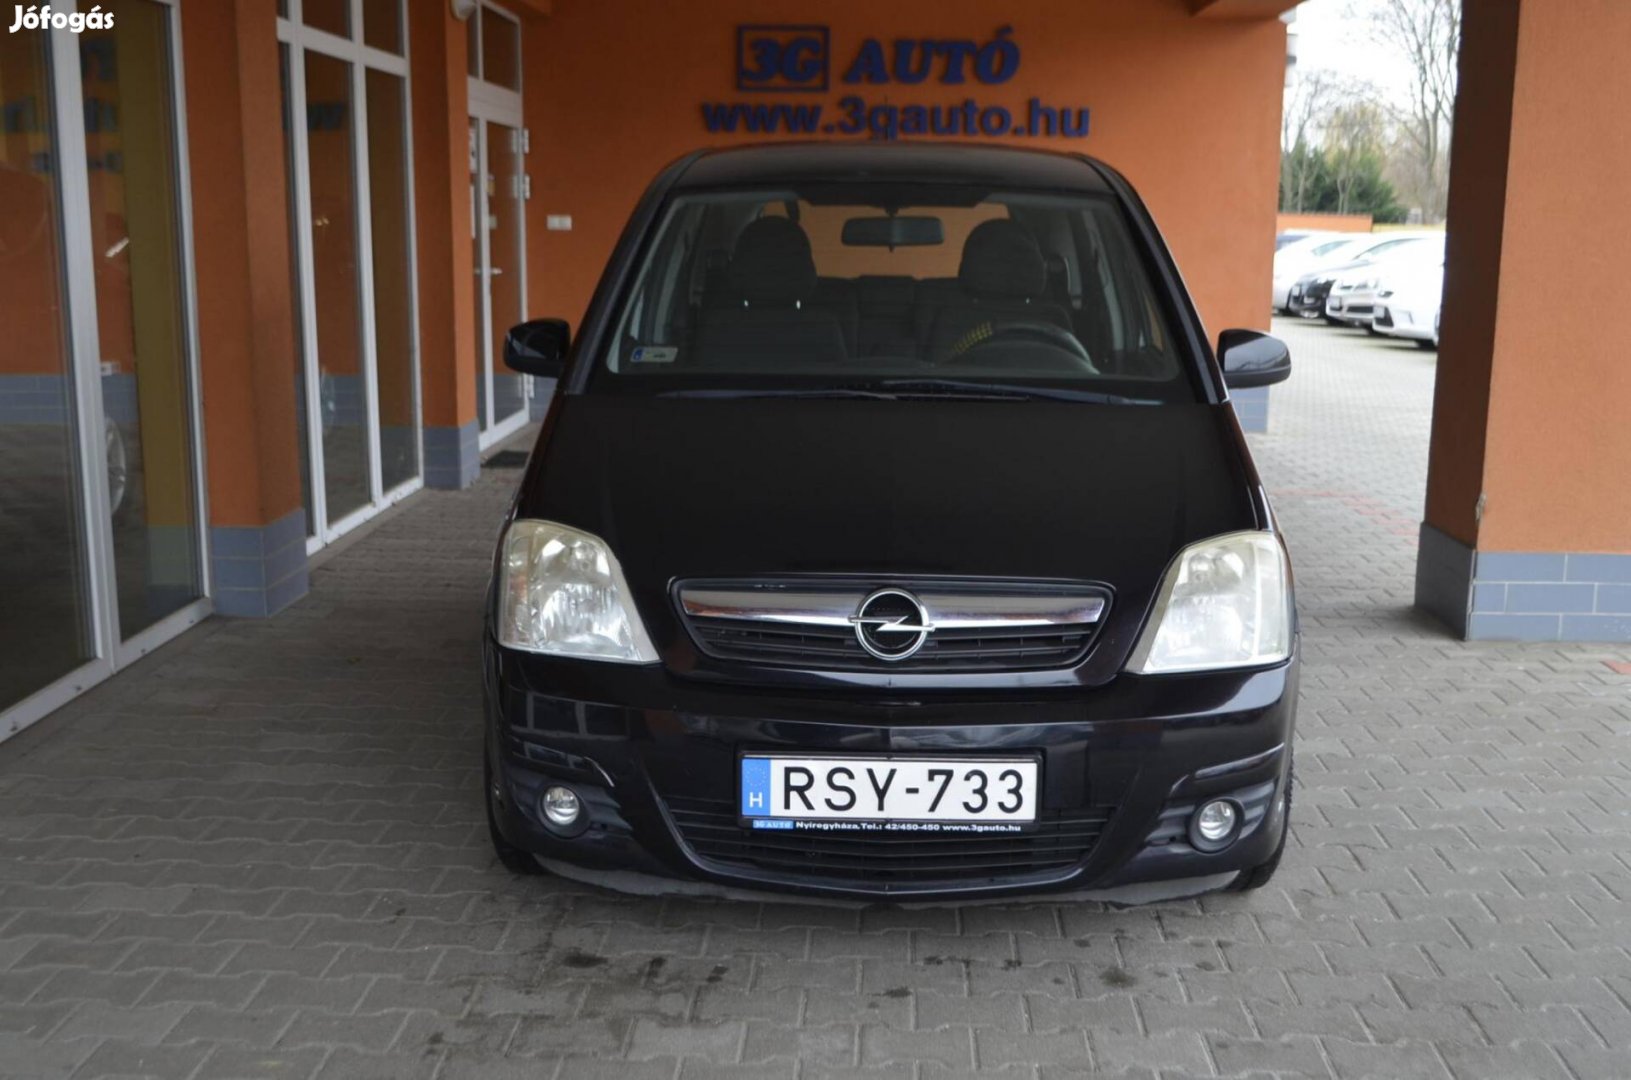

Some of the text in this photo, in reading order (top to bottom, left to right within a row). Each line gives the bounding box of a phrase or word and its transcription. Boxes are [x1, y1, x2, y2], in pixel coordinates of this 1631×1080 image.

[741, 25, 1021, 84] 3G AUTÓ
[702, 96, 1090, 140] www.3gauto.hu
[749, 792, 763, 808] H
[783, 766, 1024, 814] RSY-733
[942, 824, 1021, 832] www.3gauto.hu
